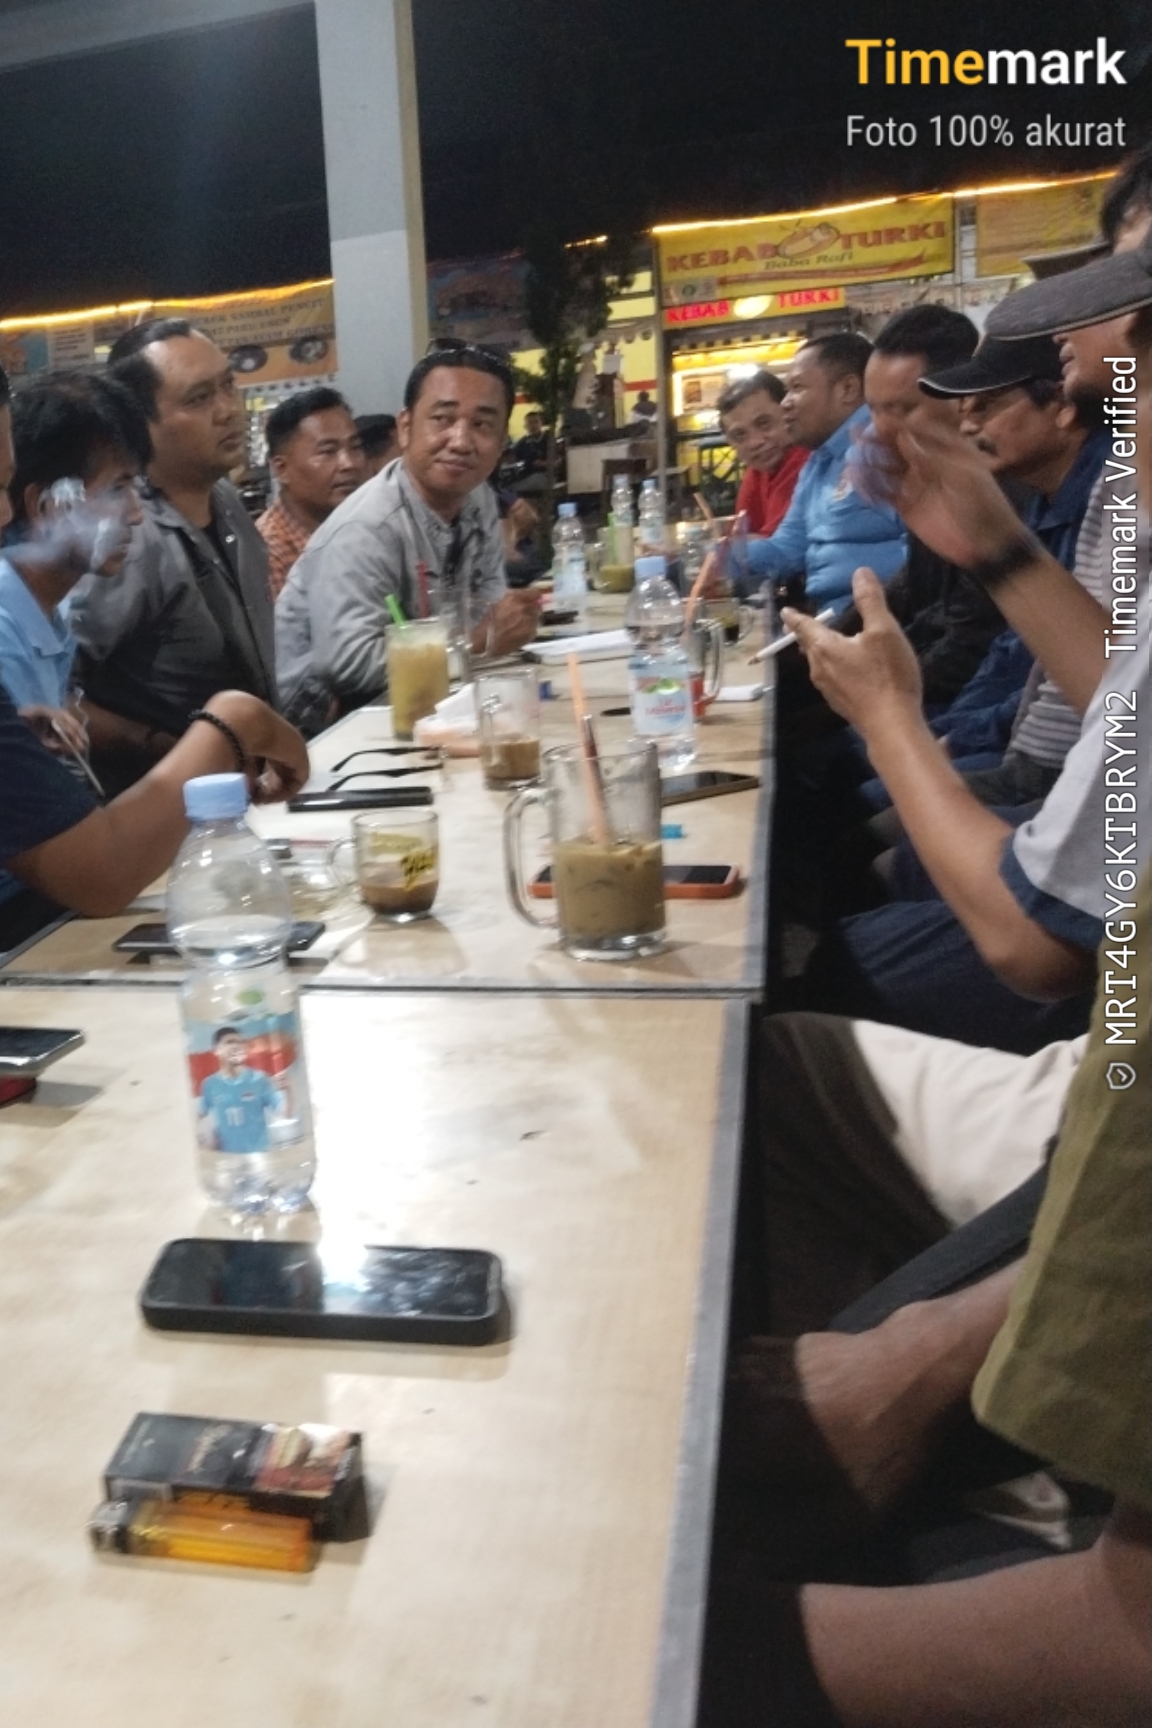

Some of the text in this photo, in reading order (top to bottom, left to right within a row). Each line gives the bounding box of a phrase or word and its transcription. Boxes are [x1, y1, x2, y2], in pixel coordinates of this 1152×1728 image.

[666, 220, 947, 273] KEBAB TURKI
[666, 299, 730, 325] KEBAB
[777, 288, 840, 309] TURKI
